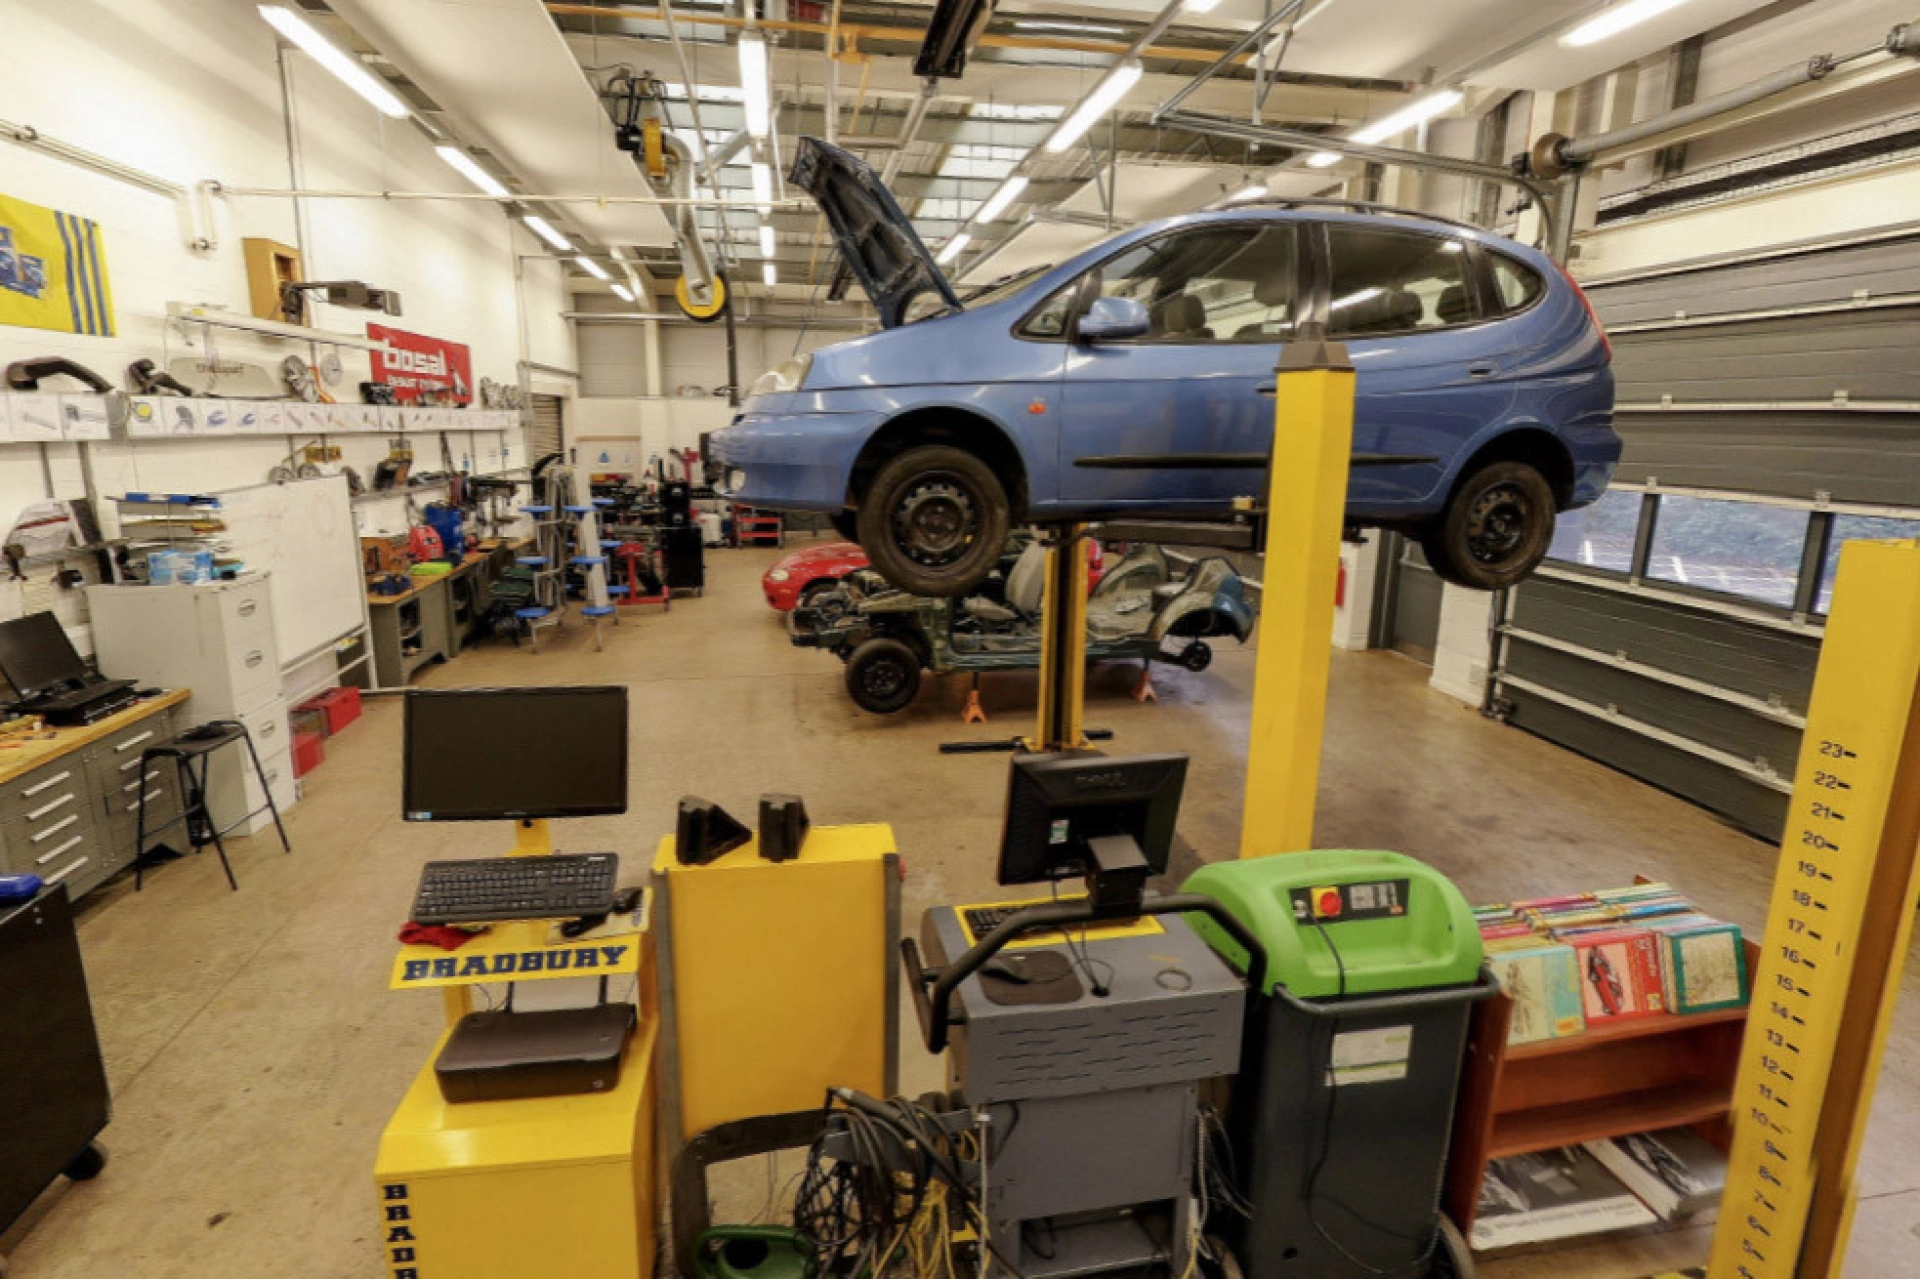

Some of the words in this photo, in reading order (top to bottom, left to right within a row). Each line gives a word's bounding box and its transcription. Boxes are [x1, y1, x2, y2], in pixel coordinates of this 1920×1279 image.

[382, 338, 447, 376] bosal
[1819, 740, 1844, 758] 23
[1814, 770, 1837, 789] 22
[1811, 801, 1831, 819] 21
[1802, 829, 1826, 849] 20
[1799, 860, 1817, 877] 19
[1793, 889, 1811, 907] 18
[1788, 918, 1805, 933] 17
[402, 946, 628, 980] BRADBURY
[1781, 946, 1799, 963] 16
[1776, 973, 1794, 991] 15
[1771, 1001, 1788, 1019] 14
[1766, 1028, 1784, 1047] 13
[1762, 1055, 1779, 1074] 12
[1759, 1083, 1773, 1101] 11
